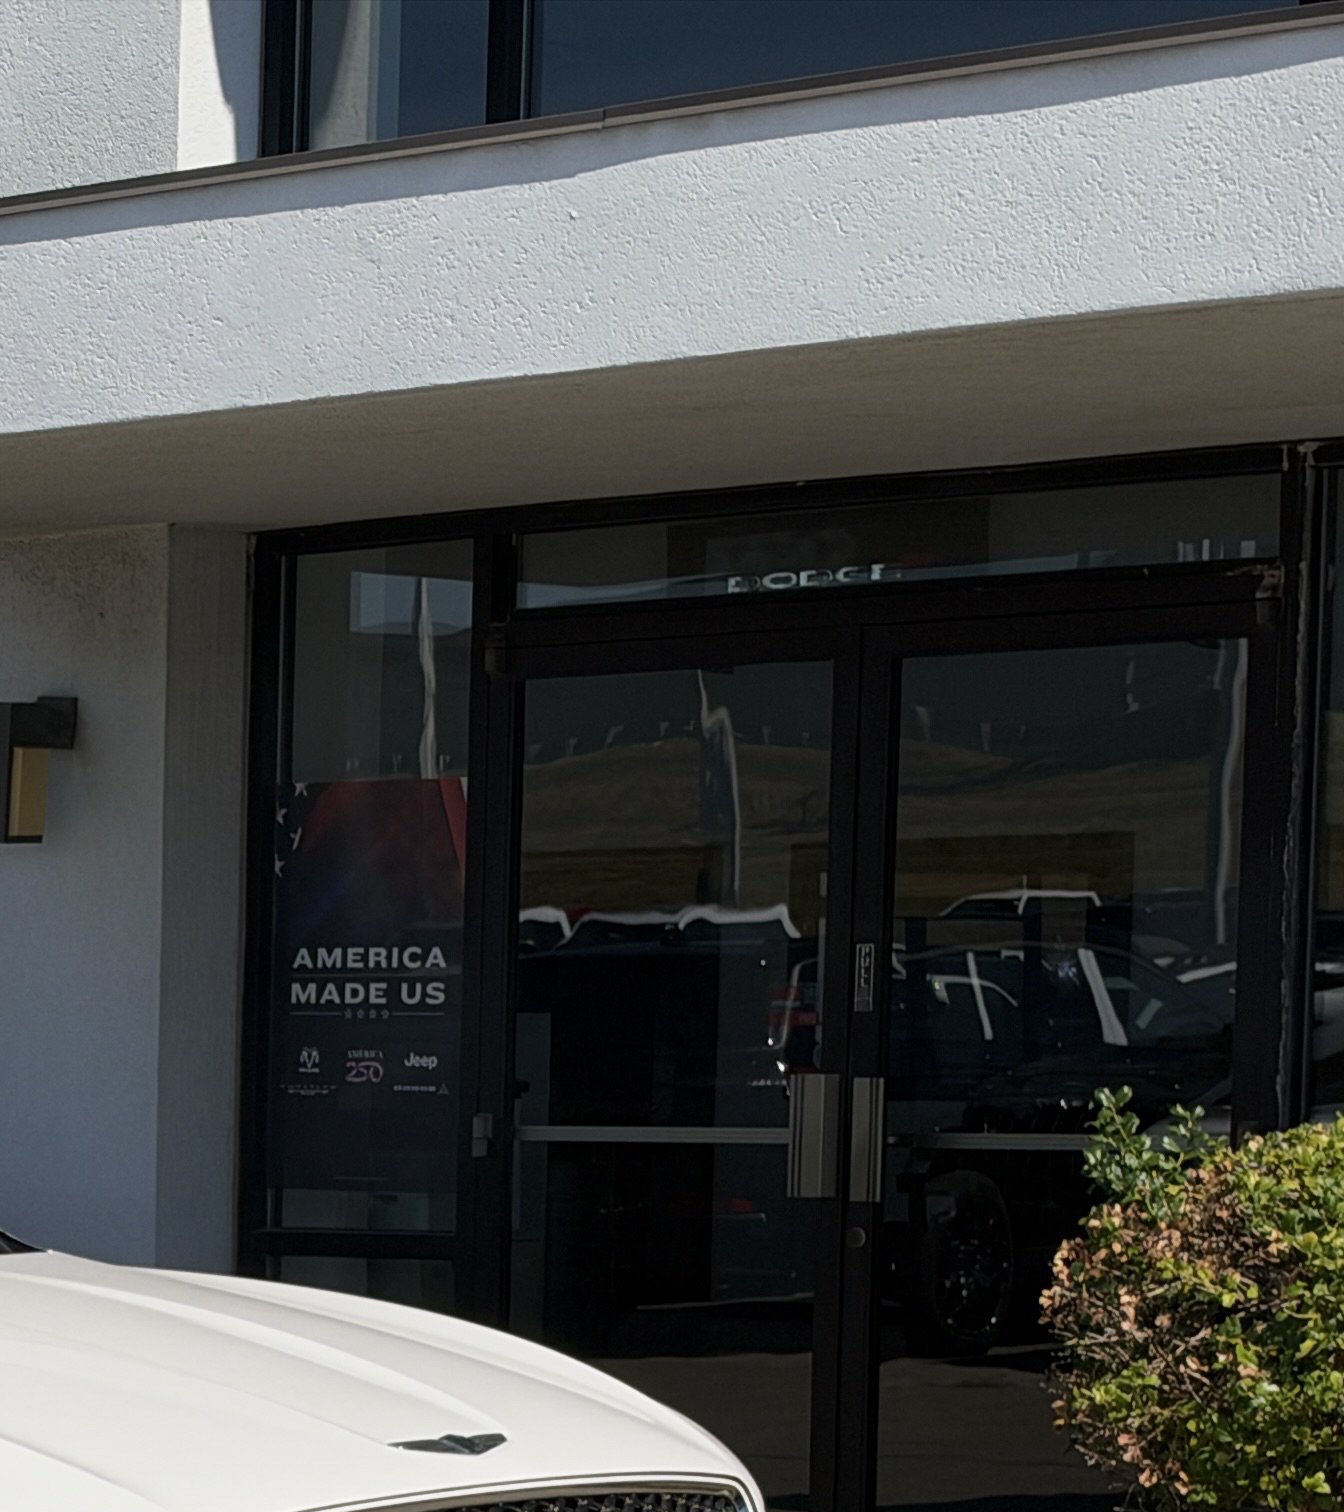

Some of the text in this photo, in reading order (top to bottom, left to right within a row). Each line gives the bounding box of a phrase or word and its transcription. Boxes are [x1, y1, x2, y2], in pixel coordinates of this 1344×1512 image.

[291, 946, 447, 970] AMERICA
[290, 982, 446, 1005] MADE US
[403, 1051, 438, 1070] Jeep
[344, 1061, 384, 1083] 250
